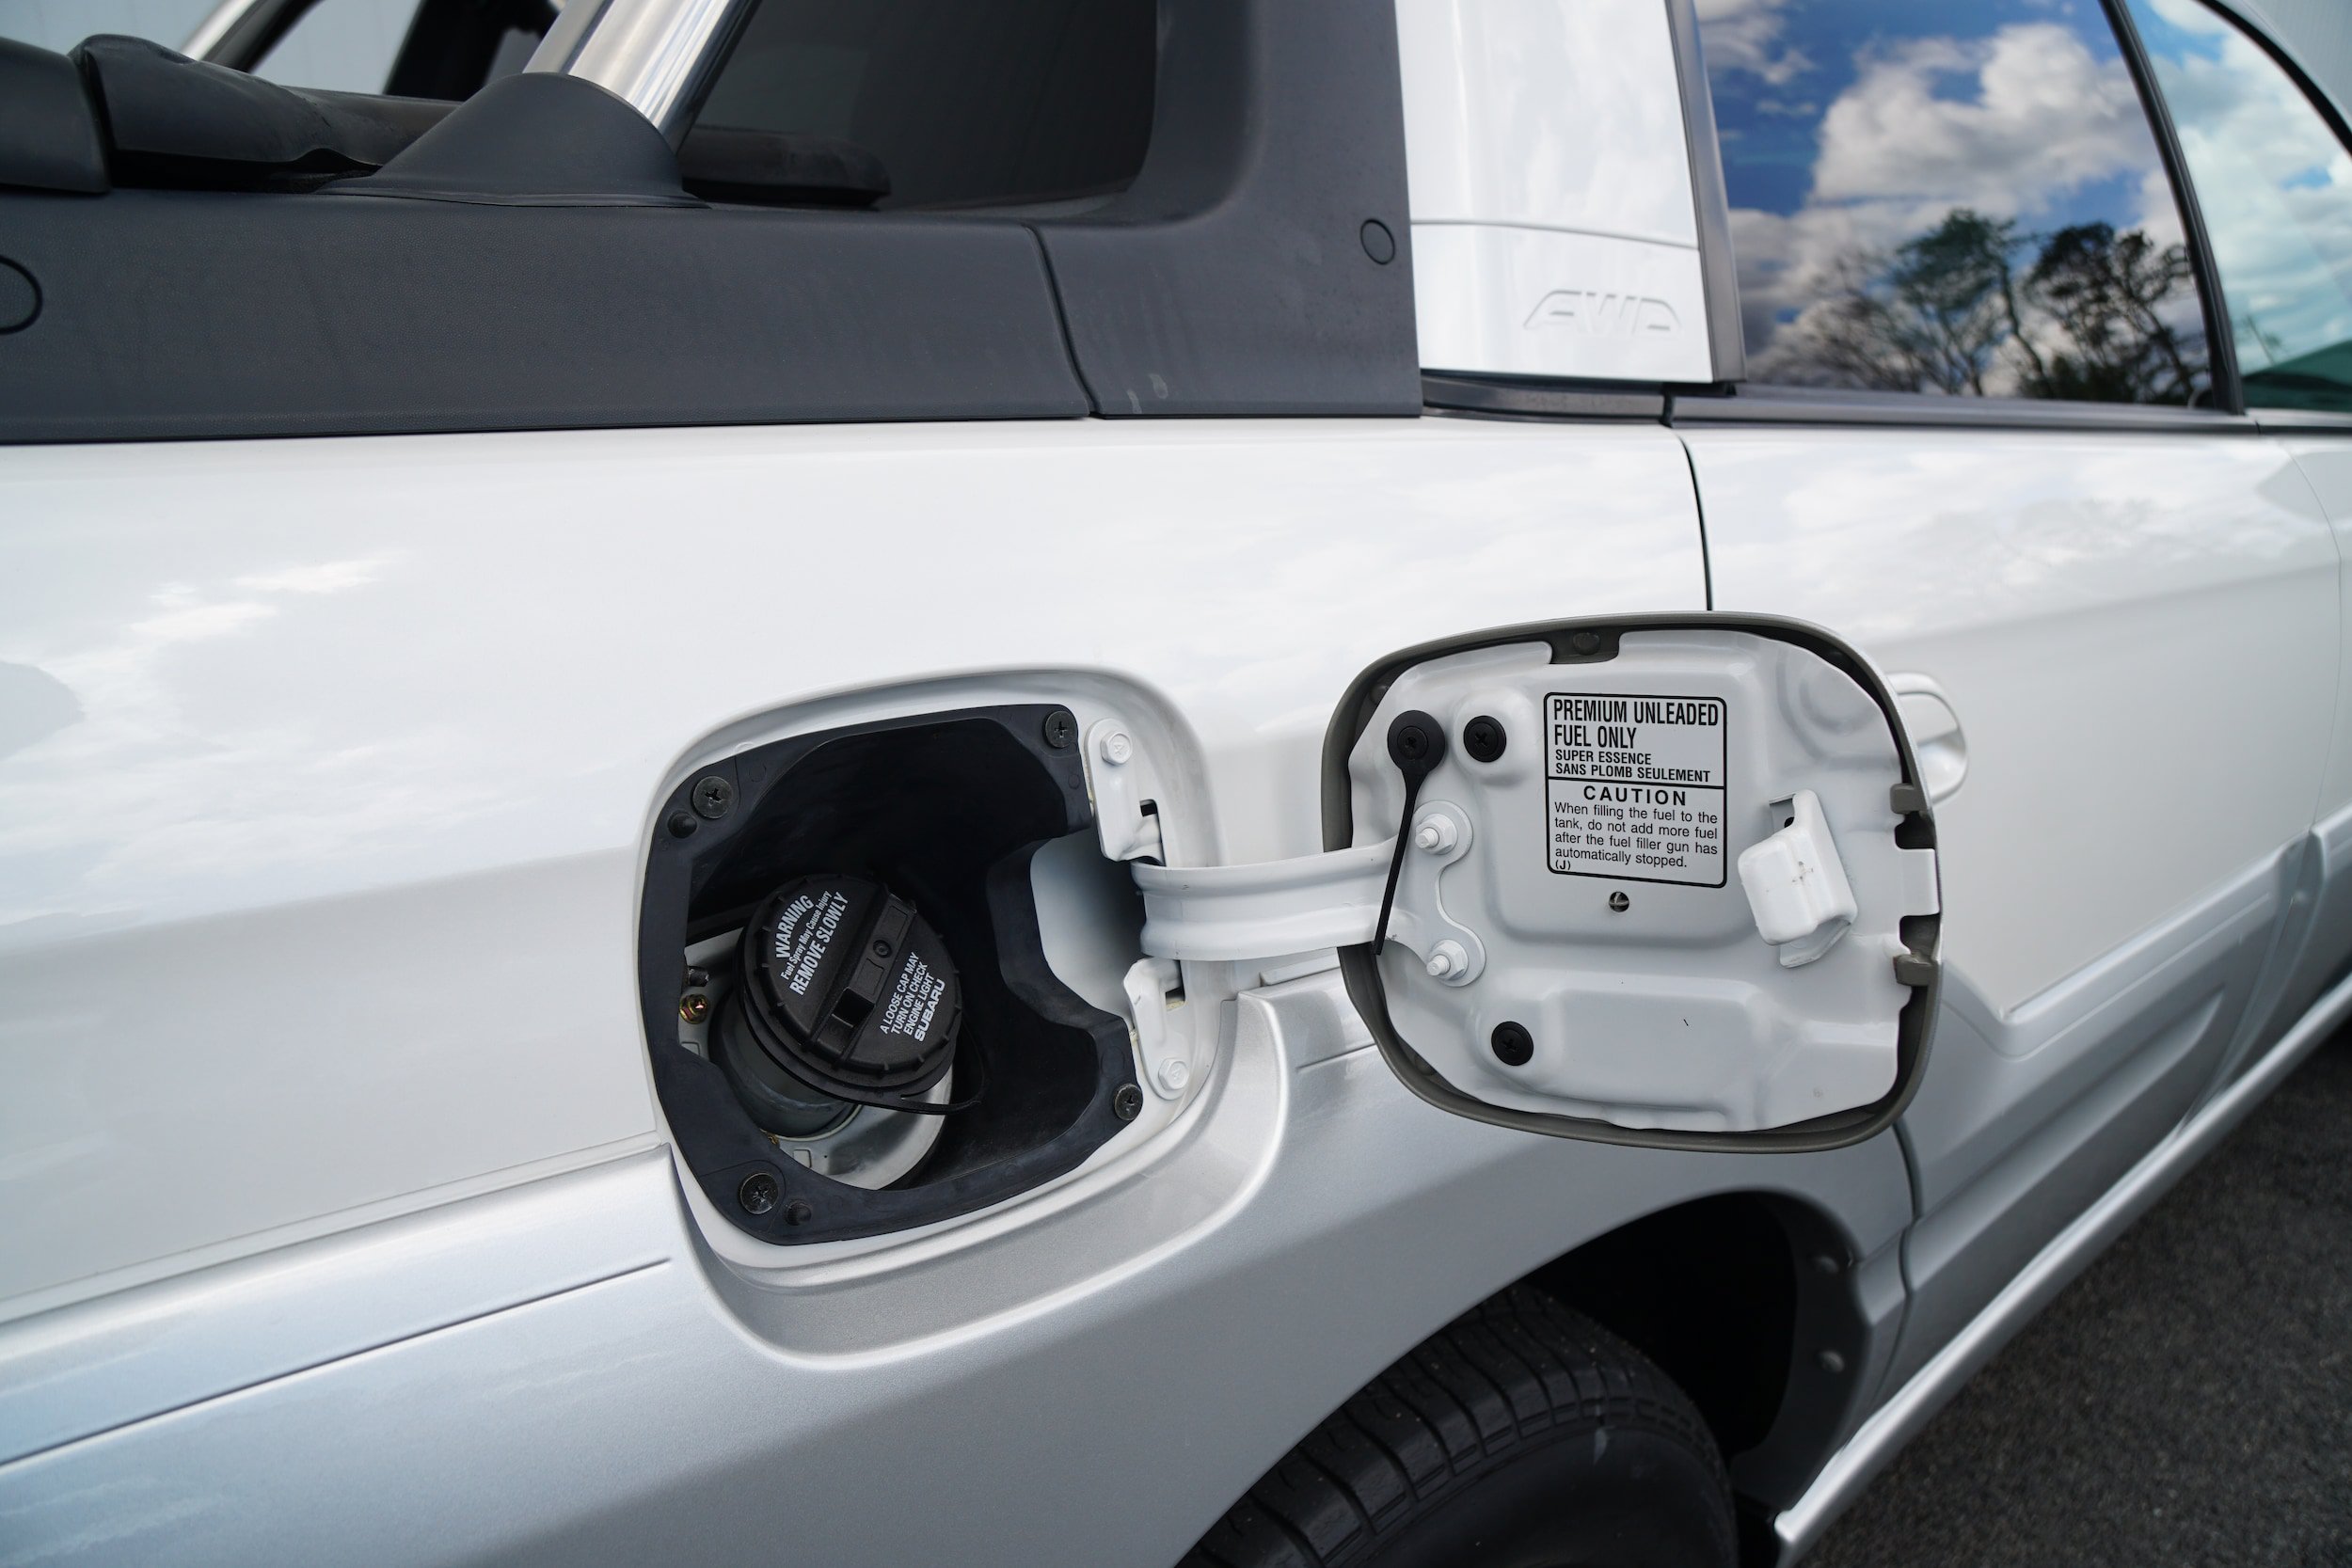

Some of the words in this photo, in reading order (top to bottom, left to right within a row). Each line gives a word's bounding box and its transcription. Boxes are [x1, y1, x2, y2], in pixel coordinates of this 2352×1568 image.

[1523, 290, 1683, 340] AWD
[1554, 699, 1628, 722] PREMIUM
[1634, 702, 1719, 726] UNLEADED
[1554, 724, 1592, 747] FUEL
[1597, 726, 1637, 749] ONLY
[1555, 750, 1594, 762] SUPER
[1598, 752, 1651, 765] ESSENCE
[1555, 764, 1586, 775] SANS
[1591, 765, 1632, 778] PLOMB
[1637, 767, 1710, 782] SEULEMENT
[1583, 786, 1686, 806] CAUTION
[1554, 802, 1588, 815] When
[1594, 804, 1624, 819] filling
[1629, 807, 1647, 818] the
[1653, 809, 1676, 820] fuel
[1681, 811, 1692, 821] to
[1698, 812, 1718, 824] the
[1555, 817, 1582, 832] tank,
[1588, 820, 1602, 831] do
[1608, 822, 1626, 832] not
[1631, 823, 1653, 834] add
[1659, 827, 1690, 836] more
[1695, 827, 1718, 839] fuel
[1555, 832, 1581, 844] after
[1586, 834, 1604, 846] the
[1609, 836, 1631, 847] fuel
[1636, 838, 1661, 849] filler
[1666, 842, 1690, 854] gun
[1695, 843, 1718, 855] has
[1555, 847, 1631, 864] automatically
[1636, 853, 1687, 868] stopped.
[1555, 860, 1571, 871] (J)
[775, 895, 814, 958] WARNING
[781, 962, 795, 980] Fuel
[789, 942, 806, 964] Spray
[799, 928, 813, 944] May
[806, 910, 822, 929] Cause
[816, 890, 833, 911] Injury
[789, 941, 826, 995] REMOVE
[816, 892, 849, 943] SLOWLY
[904, 952, 919, 974] MAY
[897, 973, 910, 993] CAP
[882, 992, 902, 1025] LOOSE
[891, 1007, 909, 1035] TURN
[903, 991, 915, 1008] ON
[909, 961, 928, 992] CHECK
[903, 999, 924, 1036] ENGINE
[918, 973, 934, 1001] LIGHT
[914, 979, 946, 1042] SUBARU
[880, 1024, 888, 1035] A
